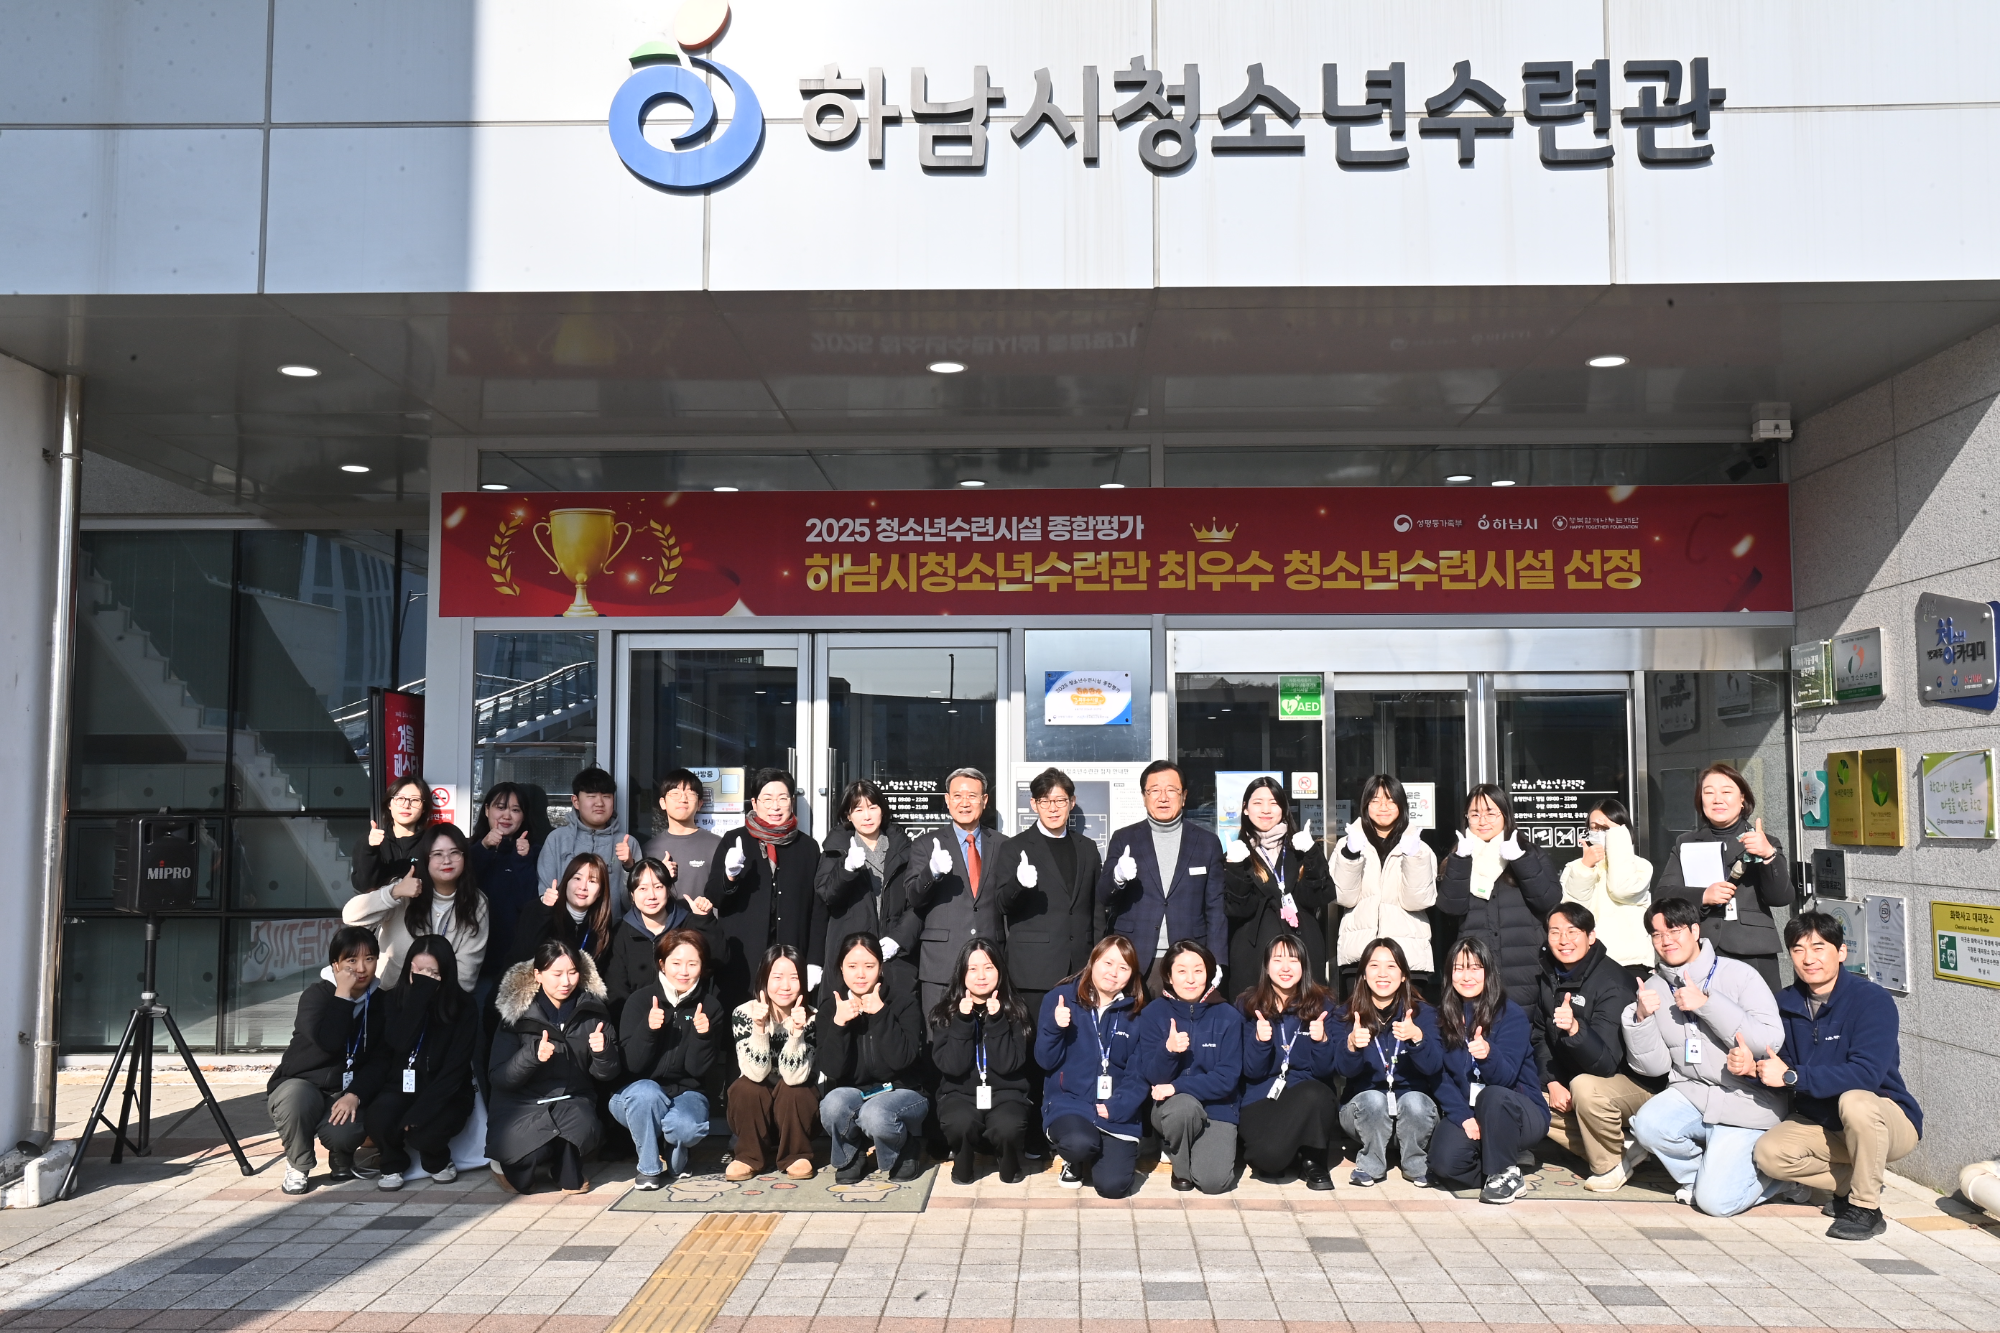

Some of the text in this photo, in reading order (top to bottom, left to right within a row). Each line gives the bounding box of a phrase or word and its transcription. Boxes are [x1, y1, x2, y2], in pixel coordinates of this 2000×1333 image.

[800, 55, 1726, 170] 하남시청소년수련관
[805, 514, 1144, 543] 2025 청소년수련시설 종합평가
[1416, 518, 1463, 528] 성평등가족부
[1492, 518, 1538, 530] 하남시
[805, 549, 1642, 593] 하남시청소년수련관 최우수 청소년수련시설 선정
[1297, 702, 1320, 711] AED
[1950, 910, 1994, 924] 화학사고 대피장소
